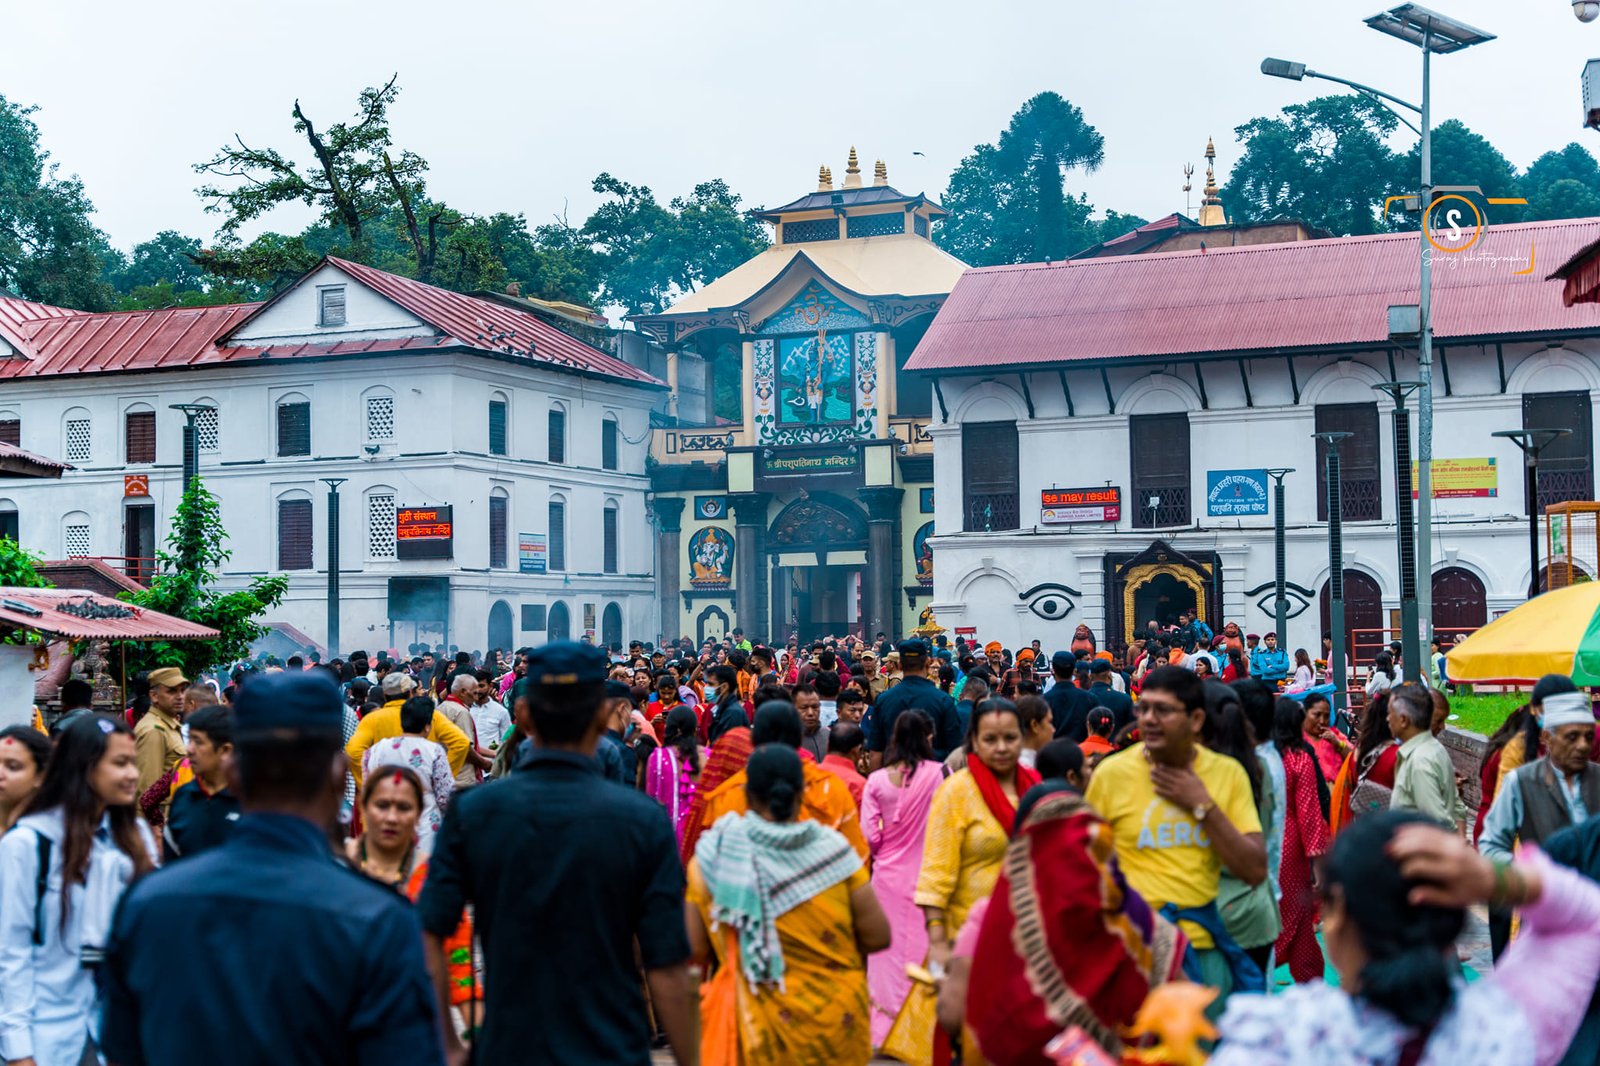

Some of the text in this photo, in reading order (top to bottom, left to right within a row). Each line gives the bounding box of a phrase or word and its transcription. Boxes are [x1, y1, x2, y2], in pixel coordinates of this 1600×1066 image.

[825, 455, 849, 466] मन्दिर
[1218, 475, 1232, 490] प्रहरी
[1061, 494, 1083, 504] may
[1086, 489, 1117, 500] result
[1210, 503, 1232, 515] पशुपति
[1233, 504, 1250, 514] सुरक्षा
[398, 510, 437, 524] गुठी संस्थान
